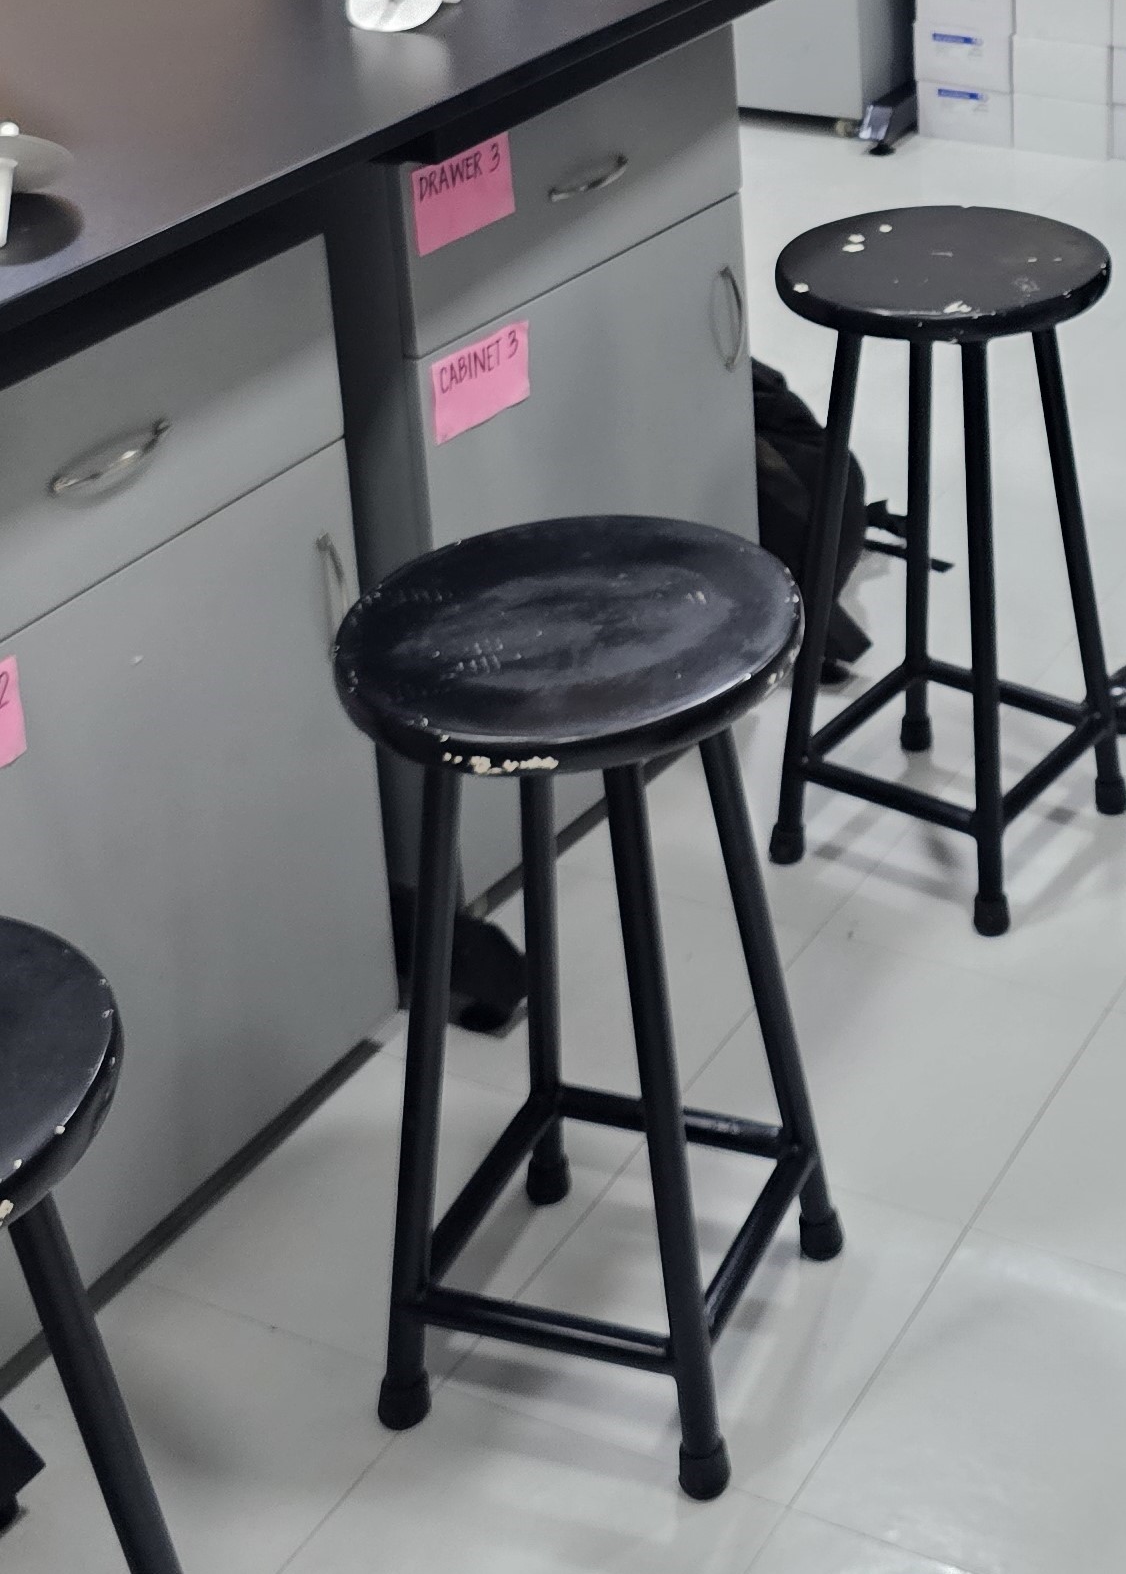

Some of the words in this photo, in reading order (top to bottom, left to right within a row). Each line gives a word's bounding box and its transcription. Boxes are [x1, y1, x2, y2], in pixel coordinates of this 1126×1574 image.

[419, 152, 483, 202] DRAWER
[490, 142, 501, 173] 3
[440, 337, 502, 394] CABINET
[508, 329, 519, 359] 3
